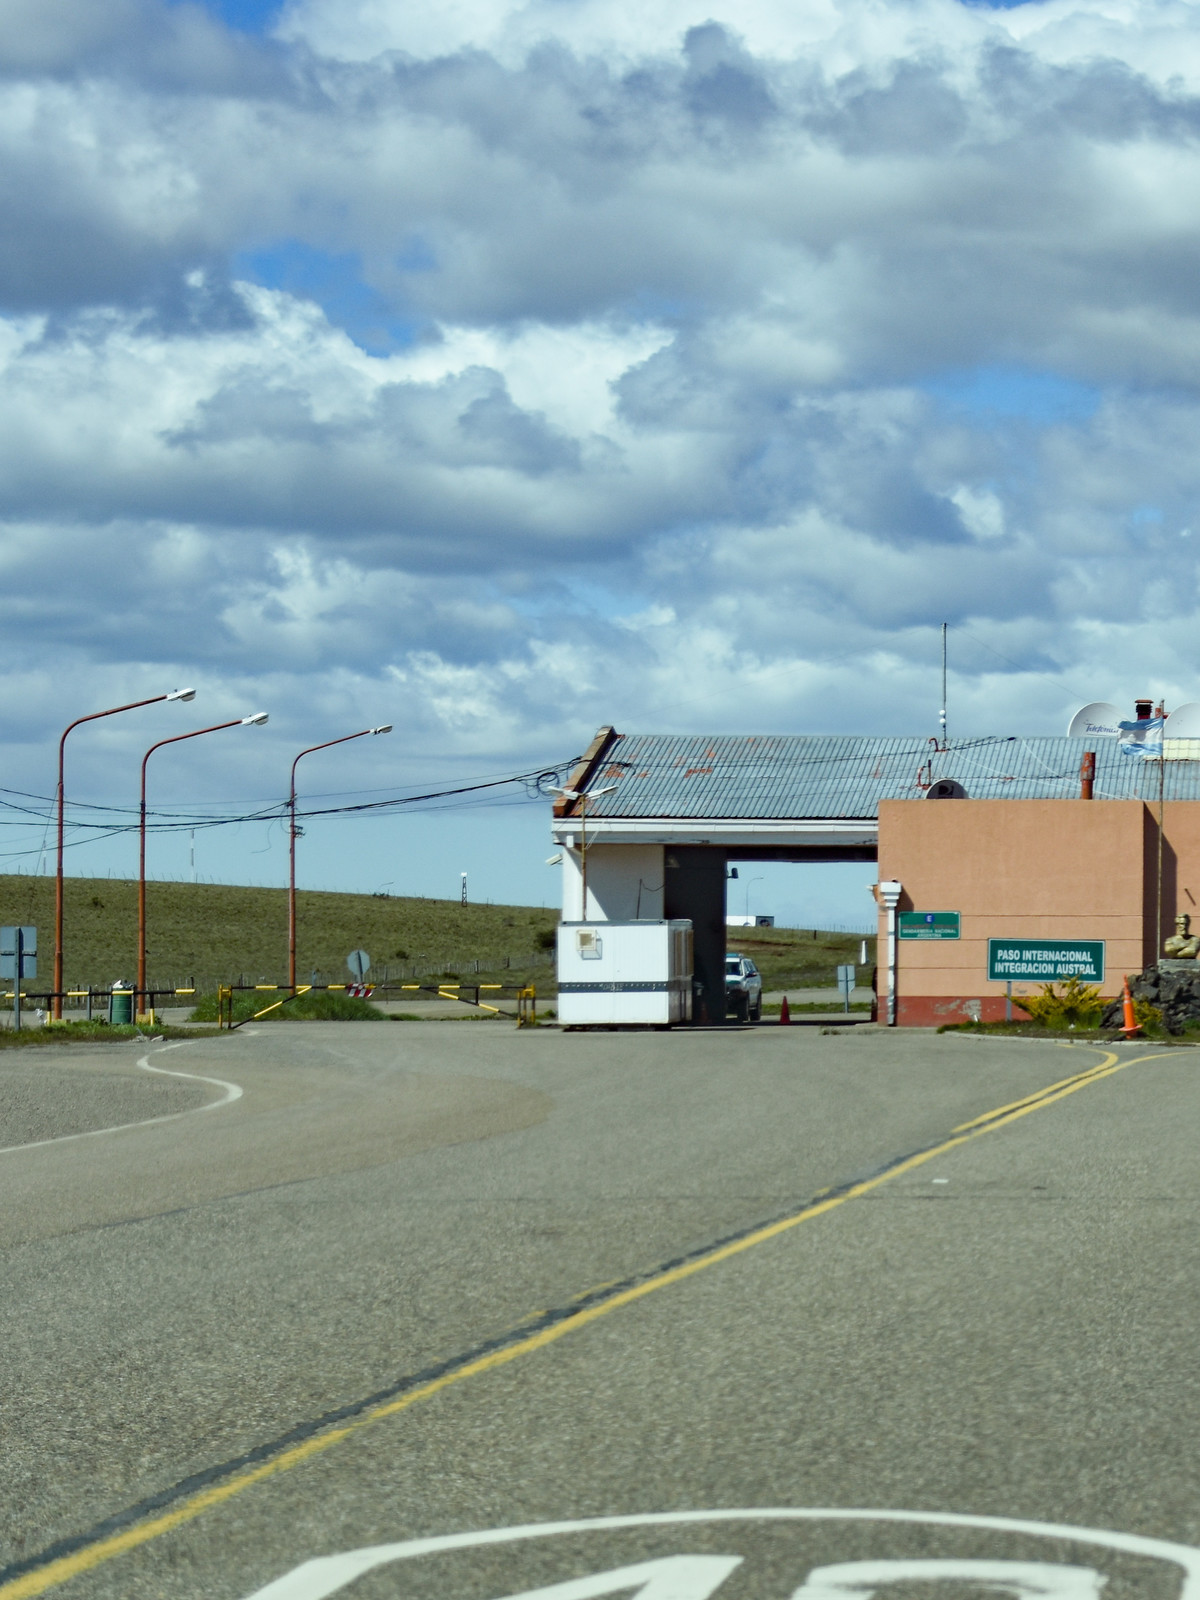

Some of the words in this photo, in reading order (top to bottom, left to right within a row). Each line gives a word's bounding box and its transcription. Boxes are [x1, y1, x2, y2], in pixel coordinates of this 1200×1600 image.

[997, 949, 1021, 961] PASO
[1022, 950, 1093, 962] INTERNACIONAL
[994, 962, 1054, 974] INTEGRACION
[1056, 963, 1097, 975] AUSTRAL
